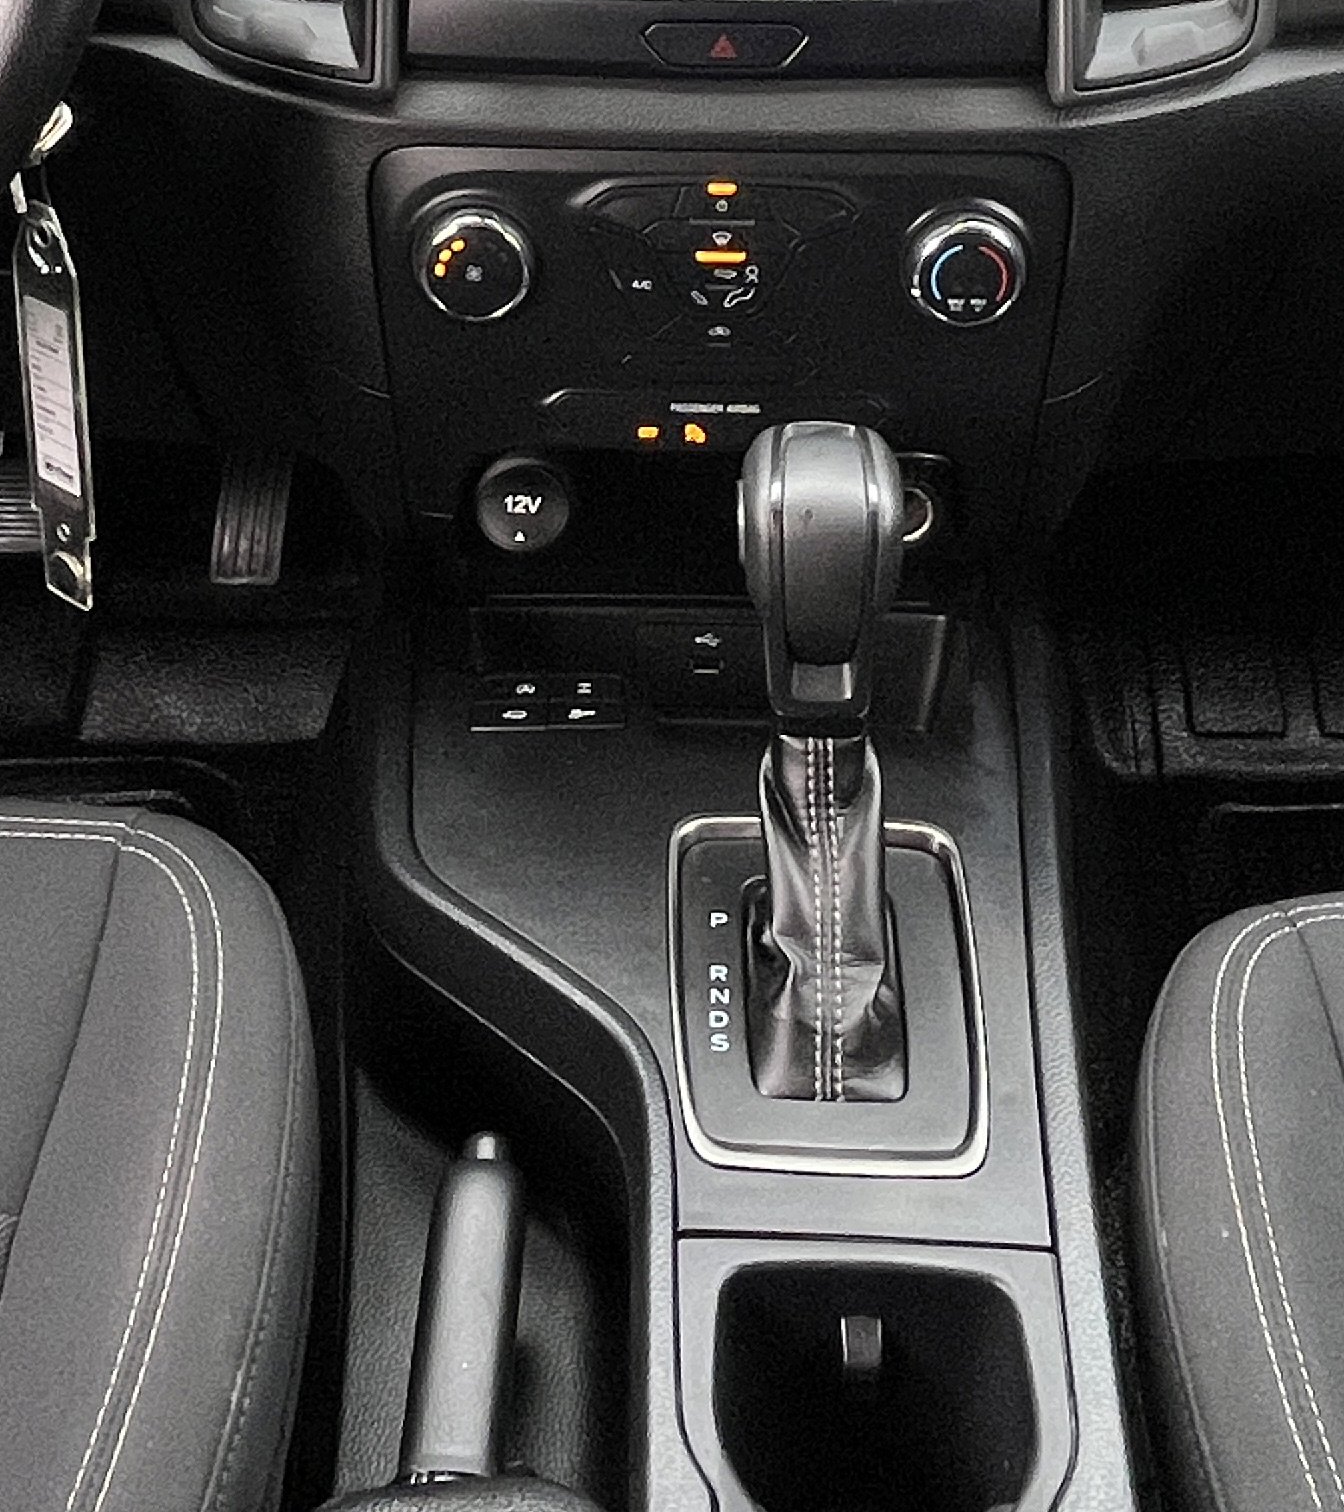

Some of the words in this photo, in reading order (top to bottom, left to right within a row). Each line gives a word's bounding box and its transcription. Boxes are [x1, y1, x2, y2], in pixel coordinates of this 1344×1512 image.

[503, 494, 543, 515] 12V
[709, 911, 729, 928] P
[709, 964, 729, 982] R
[710, 987, 730, 1004] N
[708, 1009, 731, 1028] D
[710, 1033, 730, 1052] S
